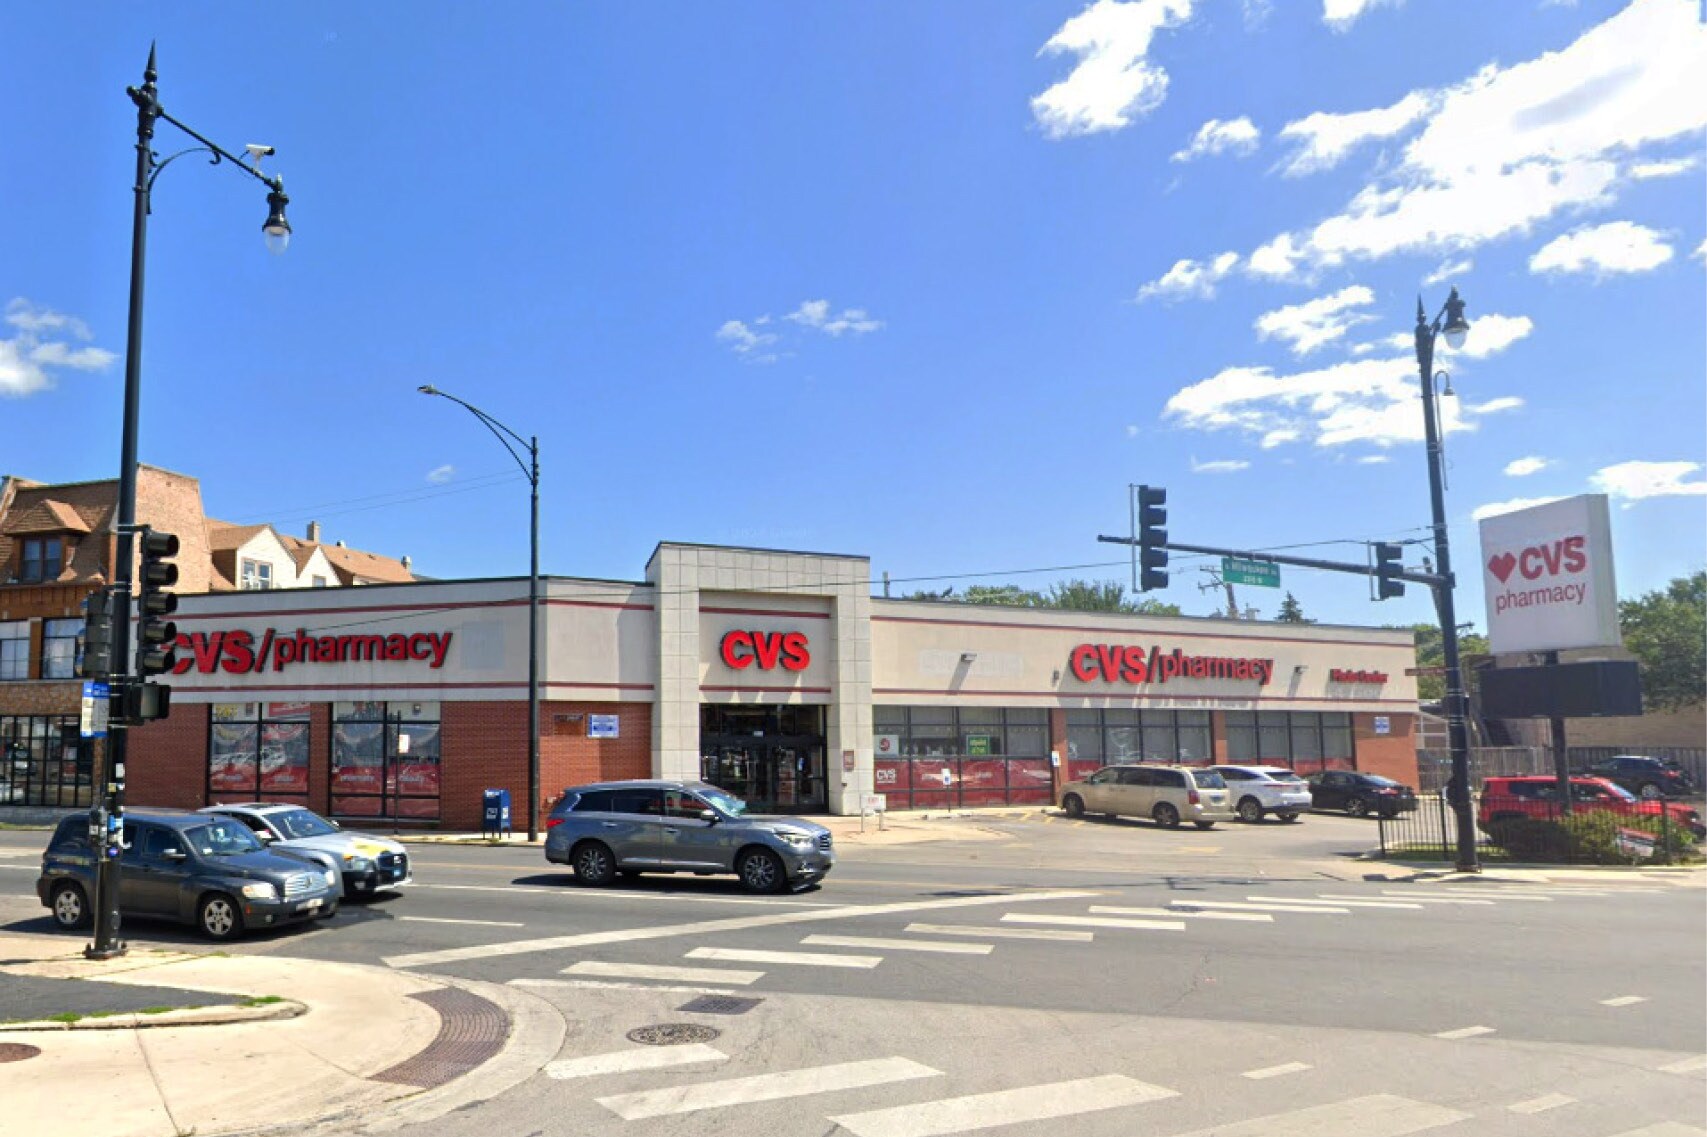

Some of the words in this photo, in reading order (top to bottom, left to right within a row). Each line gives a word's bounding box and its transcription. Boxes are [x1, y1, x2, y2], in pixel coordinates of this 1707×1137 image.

[1519, 535, 1586, 580] CVS
[1495, 583, 1586, 615] pharmacy
[720, 629, 811, 671] CVS
[1070, 643, 1274, 686] CVS/pharmacy
